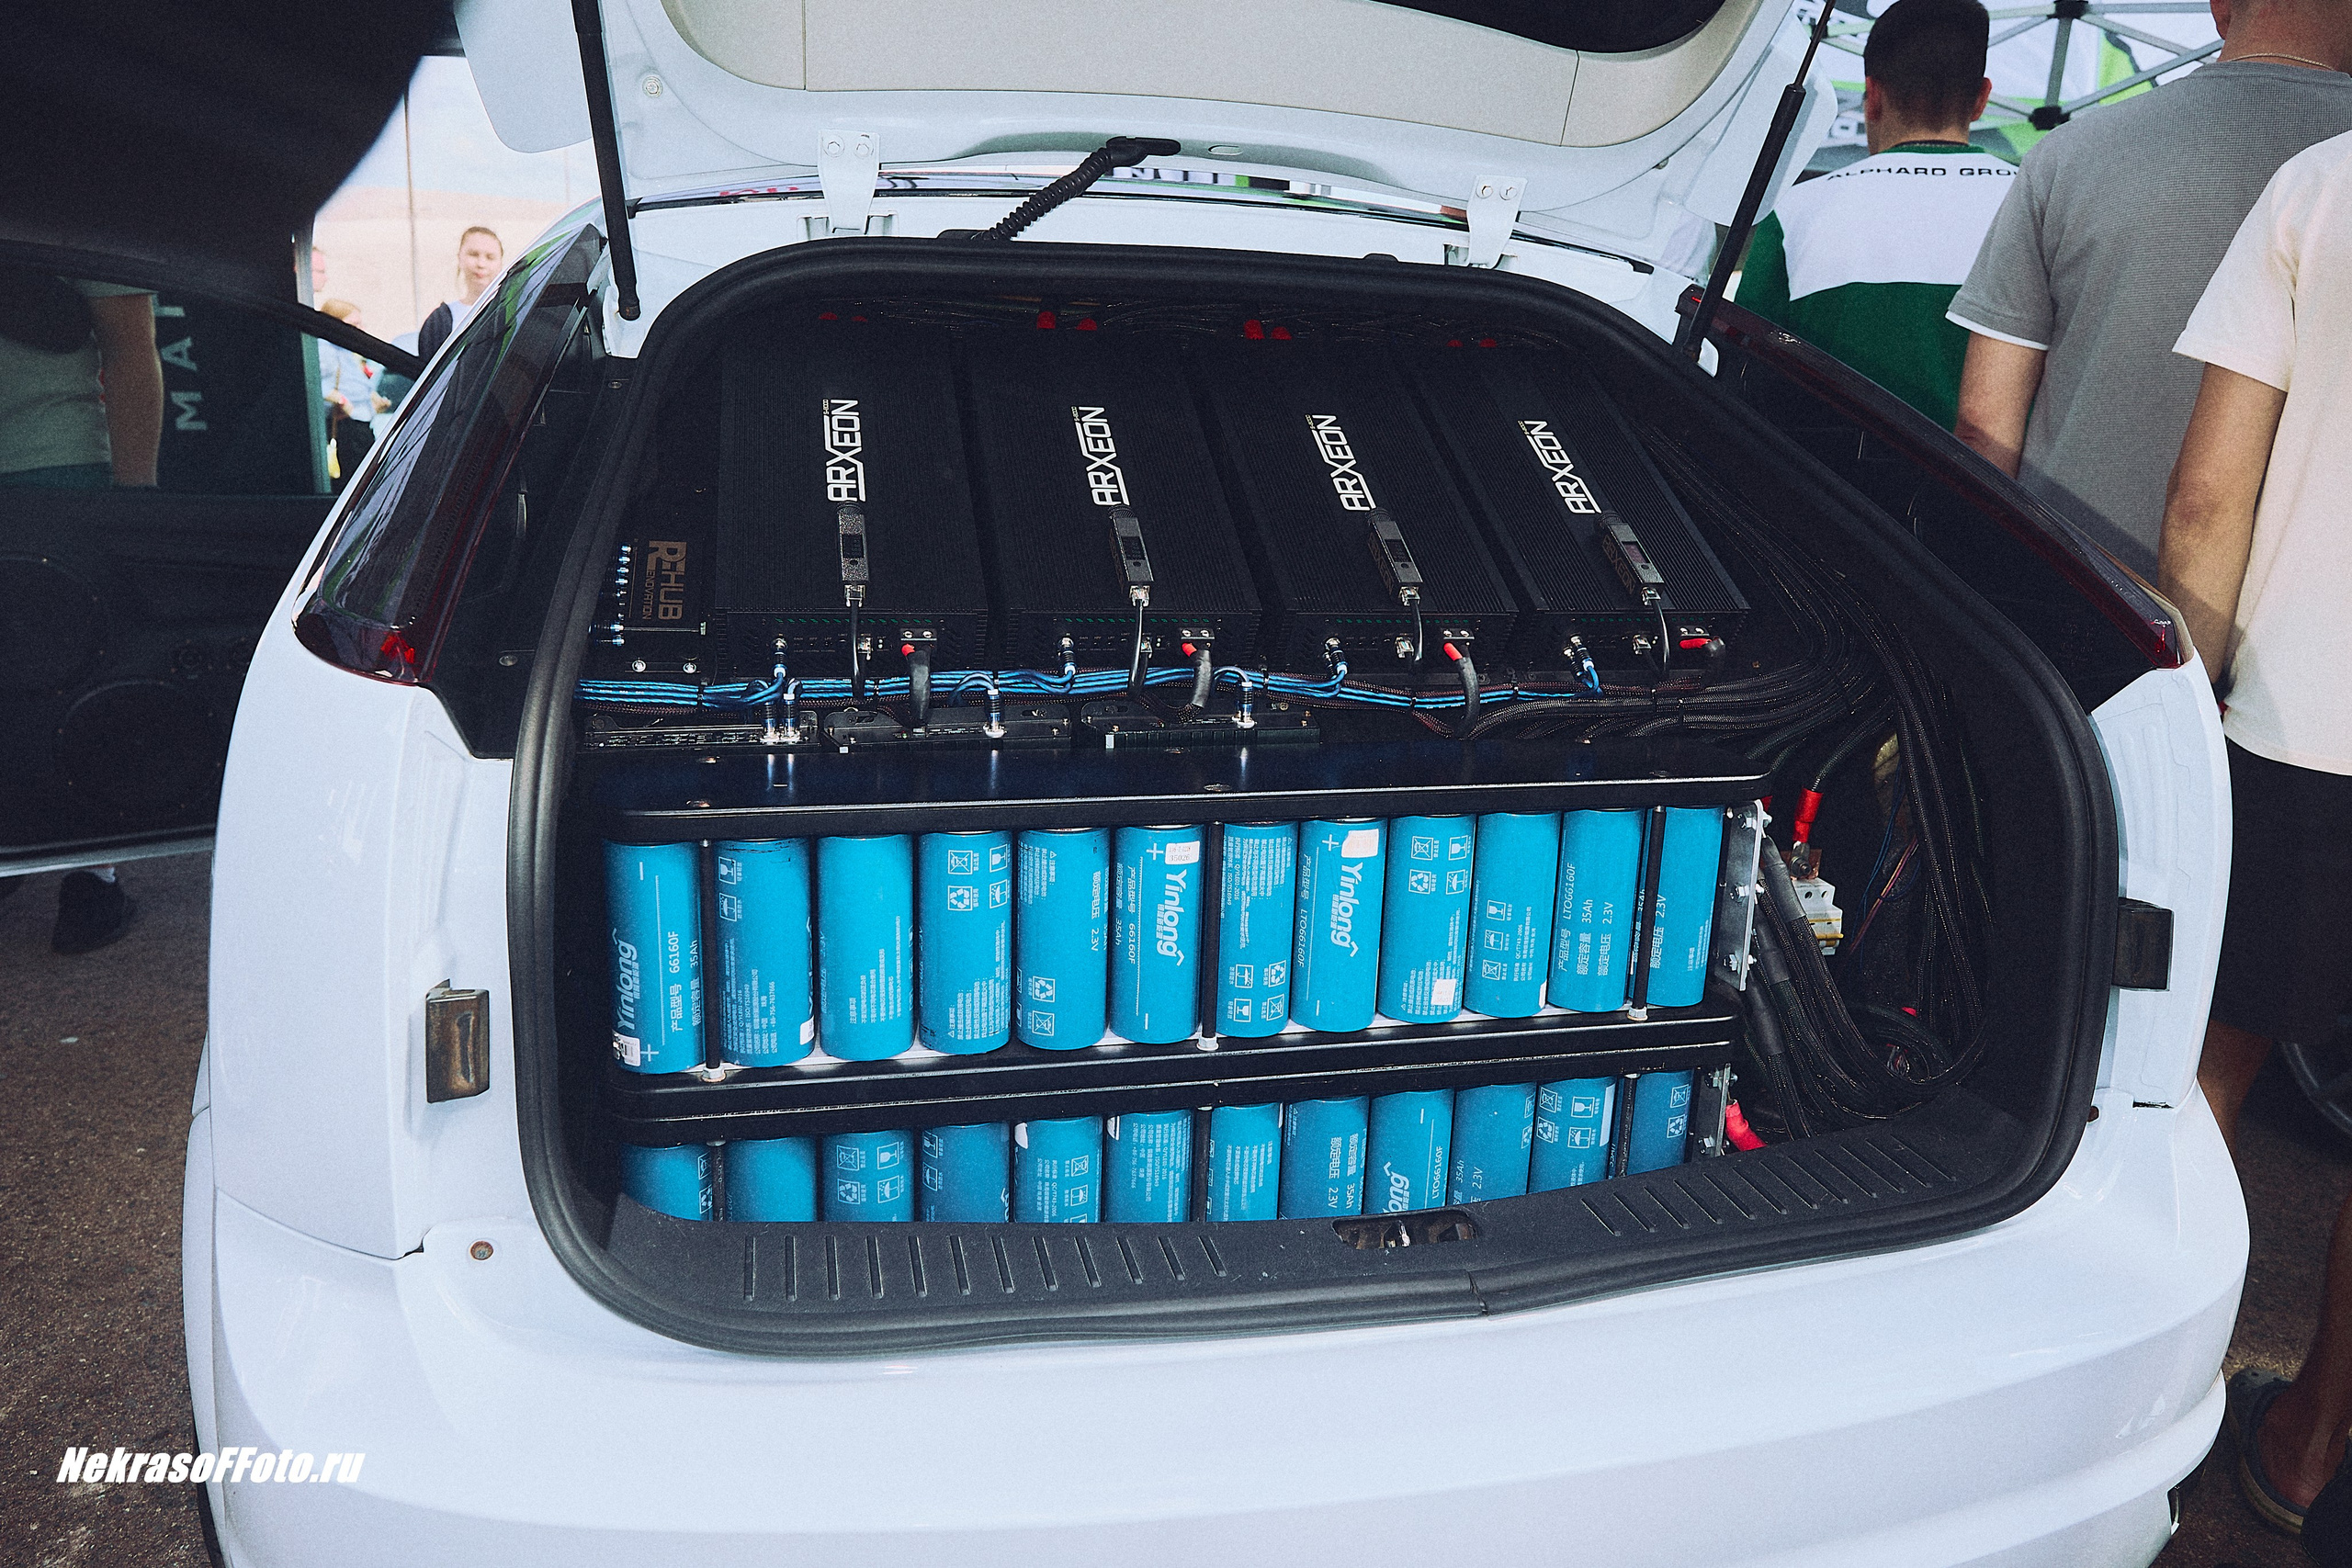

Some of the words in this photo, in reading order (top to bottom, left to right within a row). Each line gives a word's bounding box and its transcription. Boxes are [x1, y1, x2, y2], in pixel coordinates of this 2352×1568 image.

[1827, 167, 1947, 181] ALPHARD
[1960, 167, 2018, 176] GRO
[824, 400, 866, 502] ARXEON
[1075, 407, 1130, 505] ARXEON
[1312, 415, 1376, 511] ARXEON
[1524, 421, 1602, 513] ARXEON
[1601, 534, 1635, 594] ARXEON
[1127, 865, 1136, 915] 产品型号
[1329, 862, 1363, 947] Yinlong
[1562, 862, 1576, 920] LTO66160F
[1581, 898, 1594, 924] 35Ah
[1655, 894, 1667, 919] 2.3V
[1114, 918, 1123, 946] 35Ah
[1156, 869, 1187, 957] Yinlong
[1602, 901, 1614, 925] 2.3V
[668, 931, 680, 974] 66160F
[689, 940, 699, 969] 35Ah
[1091, 927, 1100, 952] 2.3V
[1127, 922, 1136, 964] 66160F
[1297, 908, 1307, 967] LTO66160F
[1557, 928, 1572, 973] 产品型号
[1576, 931, 1592, 976] 额定容量
[1597, 933, 1611, 976] 额定电压
[1649, 925, 1665, 969] 额定电压
[615, 939, 638, 1030] Yinlong
[690, 976, 701, 1027] 额定容量
[670, 984, 684, 1032] 产品型号
[1329, 1136, 1343, 1179] 额定电压
[1346, 1133, 1359, 1177] 额定容量
[1431, 1145, 1443, 1200] LTO66160F
[1455, 1159, 1465, 1184] 35Ah
[1328, 1187, 1339, 1209] 2.3V
[1345, 1182, 1355, 1209] 35Ah
[1472, 1166, 1484, 1190] 2.3V
